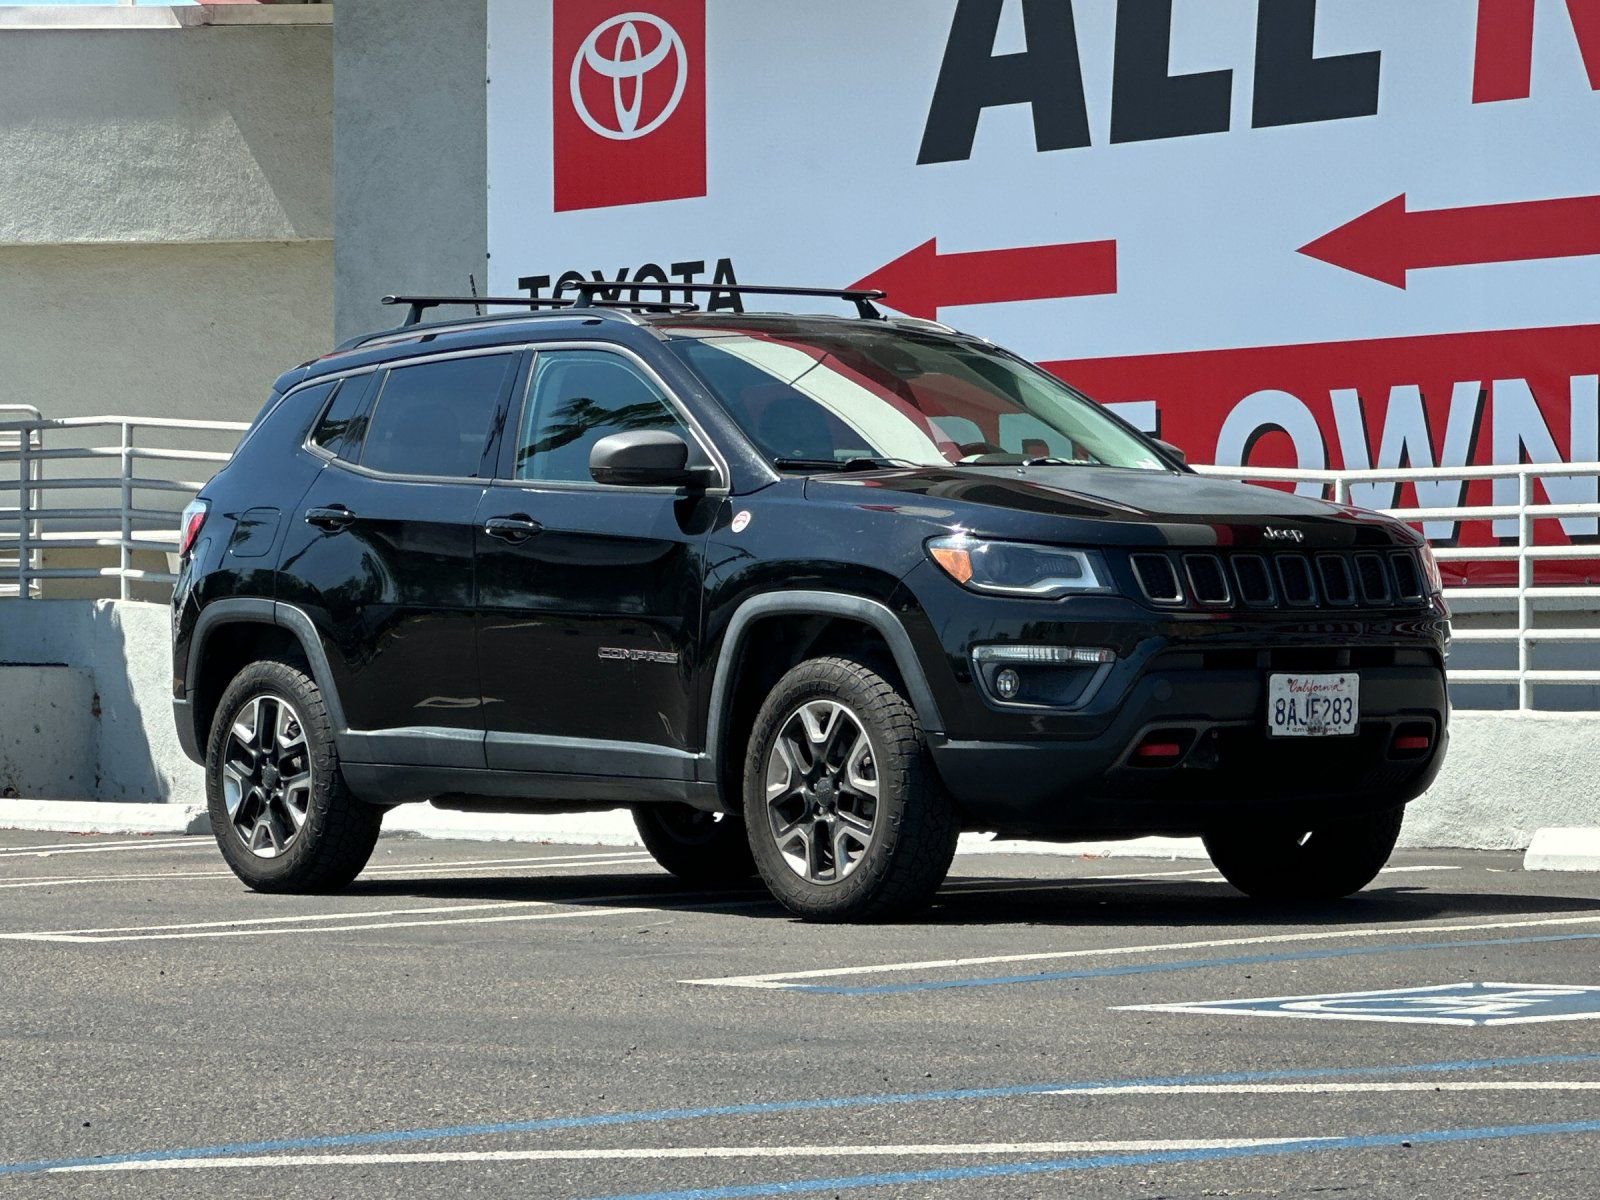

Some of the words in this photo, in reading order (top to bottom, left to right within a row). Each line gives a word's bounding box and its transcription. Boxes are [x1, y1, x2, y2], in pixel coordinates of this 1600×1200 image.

[916, 0, 1381, 165] ALL
[518, 257, 744, 313] TOYOTA
[1263, 525, 1305, 543] Jeep
[597, 646, 679, 664] COMPASS
[1289, 678, 1344, 698] California
